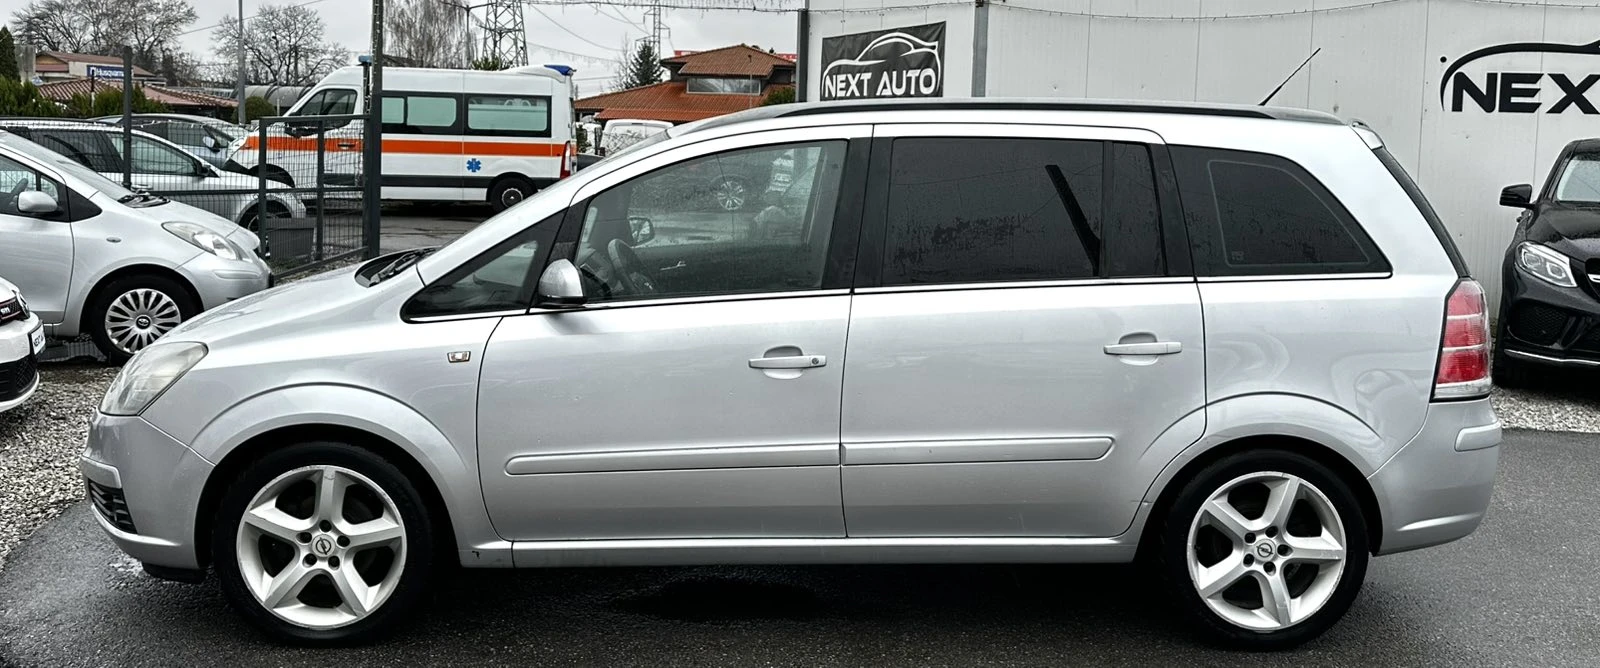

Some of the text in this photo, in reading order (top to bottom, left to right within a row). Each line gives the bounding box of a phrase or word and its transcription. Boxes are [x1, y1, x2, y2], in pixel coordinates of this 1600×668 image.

[825, 68, 936, 98] NEXT AUTO
[1451, 71, 1600, 115] NEX
